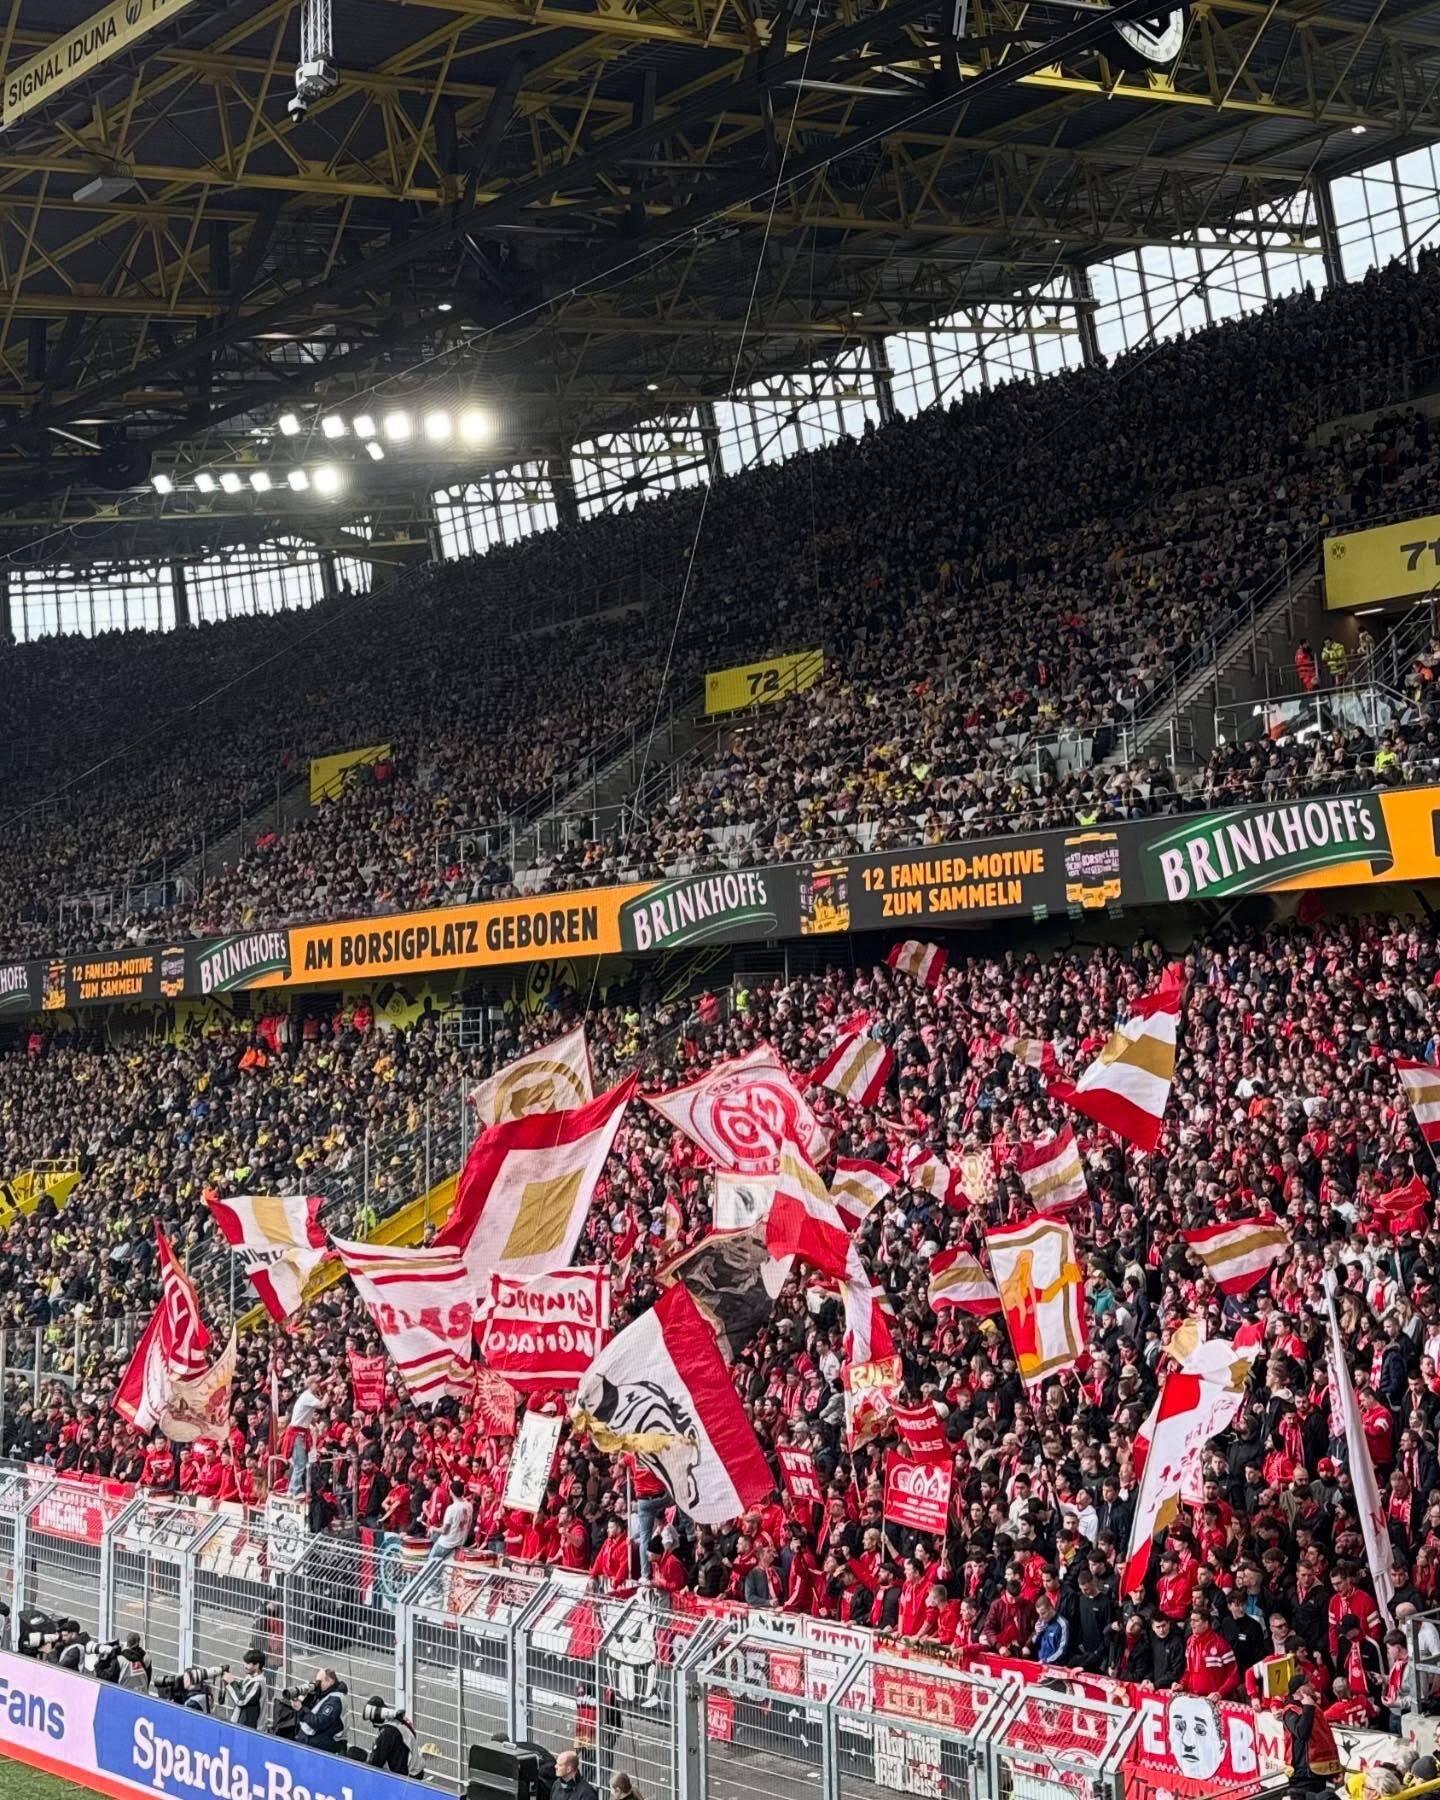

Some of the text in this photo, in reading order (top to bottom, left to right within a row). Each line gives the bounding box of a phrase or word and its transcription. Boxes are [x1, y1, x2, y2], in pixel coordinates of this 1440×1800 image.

[9, 16, 117, 107] SIGNAL IDUNA
[746, 669, 779, 695] 72
[862, 867, 885, 891] 12
[890, 848, 1044, 889] FANLIED-MOTIVE
[1159, 799, 1376, 901] BRINKHOFF's
[632, 872, 768, 951] BRINKHOFF's
[882, 890, 923, 917] ZUM
[928, 880, 1022, 913] SAMMELN
[304, 905, 598, 971] AM BORSIGPLATZ GEBOREN
[72, 966, 83, 981] 12
[84, 957, 153, 980] FANLIED-MOTIVE
[79, 982, 98, 999] ZUM
[100, 978, 143, 997] SAMMELN
[883, 1680, 956, 1726] GOLD
[133, 1717, 353, 1800] Sparda-B
